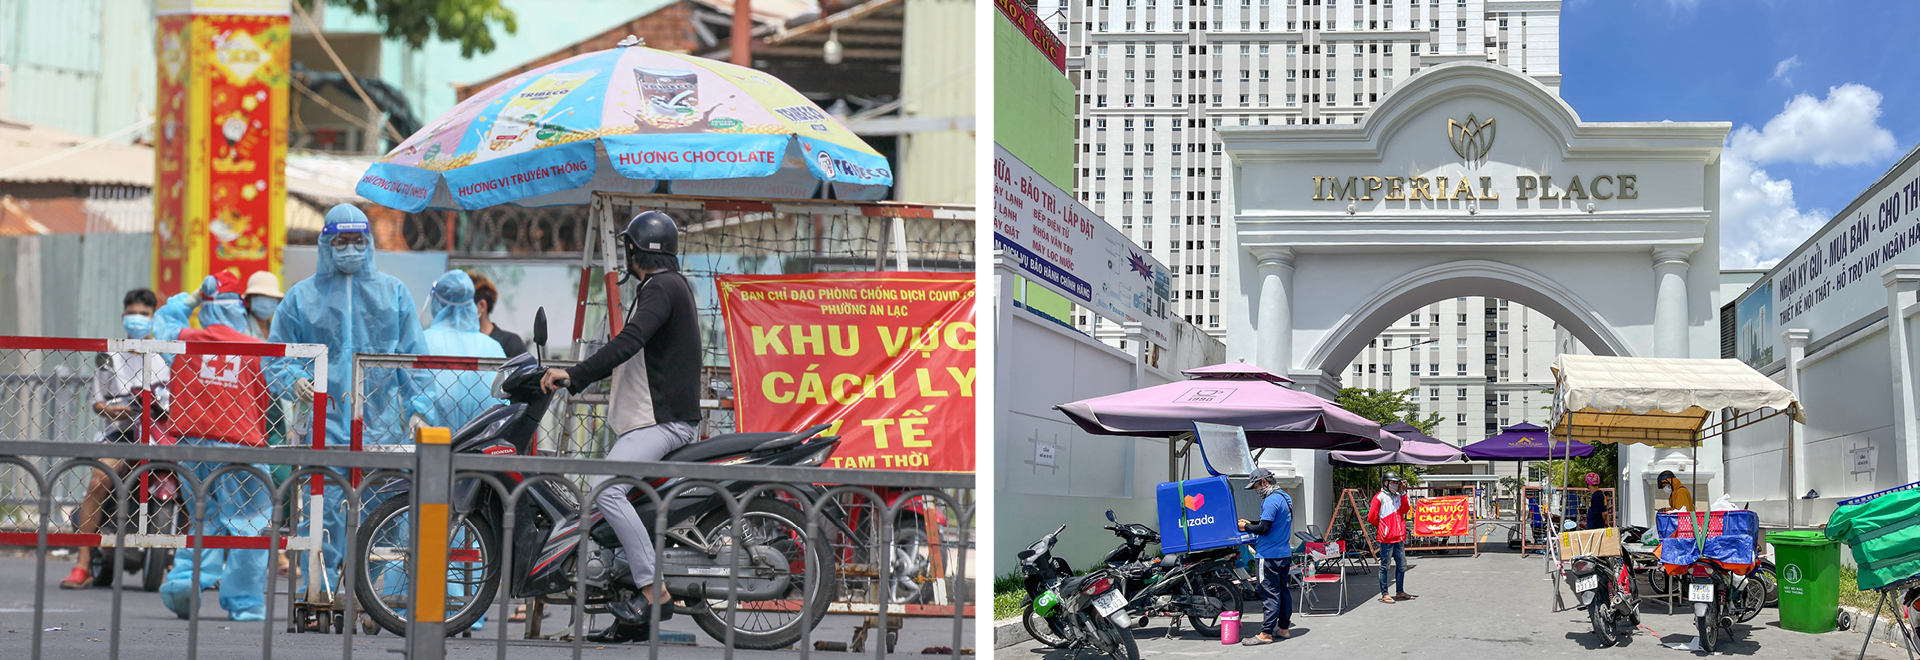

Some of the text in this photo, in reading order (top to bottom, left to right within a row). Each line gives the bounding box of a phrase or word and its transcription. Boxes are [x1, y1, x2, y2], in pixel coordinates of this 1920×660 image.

[1032, 30, 1057, 60] CÚC
[520, 89, 569, 98] TRIBECO
[620, 150, 775, 165] HƯƠNG CHOCOLATE
[362, 174, 392, 190] HƯƠNG
[458, 180, 498, 197] HƯƠNG
[498, 178, 510, 190] VỊ
[550, 160, 587, 177] THỐNG
[1312, 175, 1638, 200] IMPERIAL PLACE
[1006, 190, 1023, 209] LẠNH
[1021, 176, 1040, 203] BẢO
[1042, 191, 1056, 214] TRÌ
[1064, 204, 1078, 228] LẮP
[1080, 218, 1094, 240] ĐẶT
[999, 204, 1017, 222] LẠNH
[1033, 209, 1046, 222] BẾP
[1047, 218, 1060, 234] ĐIỆN
[1004, 224, 1020, 240] GIẶT
[1033, 224, 1073, 255] KHÓA VÂN TAY
[1780, 267, 1796, 302] NHẬN
[1798, 255, 1808, 289] KÝ
[1810, 242, 1822, 281] GỬI
[1830, 231, 1847, 267] MUA
[1850, 212, 1869, 253] BÁN
[1879, 192, 1900, 233] CHO
[1903, 176, 1920, 215] TH
[1032, 240, 1074, 271] MÁY LỌC NƯỚC
[1030, 258, 1042, 274] BẢO
[1044, 265, 1059, 282] HÀNH
[1060, 275, 1076, 291] CHÍNH
[1077, 283, 1090, 298] HÃNG
[1780, 300, 1794, 326] THIẾT
[1795, 293, 1803, 317] KẾ
[1804, 290, 1814, 312] NỘI
[1815, 276, 1830, 304] THẤT
[1837, 263, 1846, 291] HỖ
[1848, 257, 1863, 283] TRỢ
[1865, 248, 1880, 273] VAY
[1883, 232, 1905, 263] NGÂN
[741, 291, 765, 301] BAN
[768, 288, 787, 300] CHỈ
[791, 289, 815, 302] ĐẠO
[818, 286, 858, 300] PHÒNG
[860, 284, 897, 300] CHỐNG
[900, 289, 926, 302] DỊCH
[821, 302, 908, 318] PHƯỜNG AN LẠC
[751, 320, 976, 358] KHU VỰC
[762, 364, 976, 405] CÁCH LY
[862, 405, 936, 449] TẾ
[881, 452, 929, 467] THỜI
[1443, 505, 1464, 513] VỰC
[1102, 599, 1123, 614] 7503
